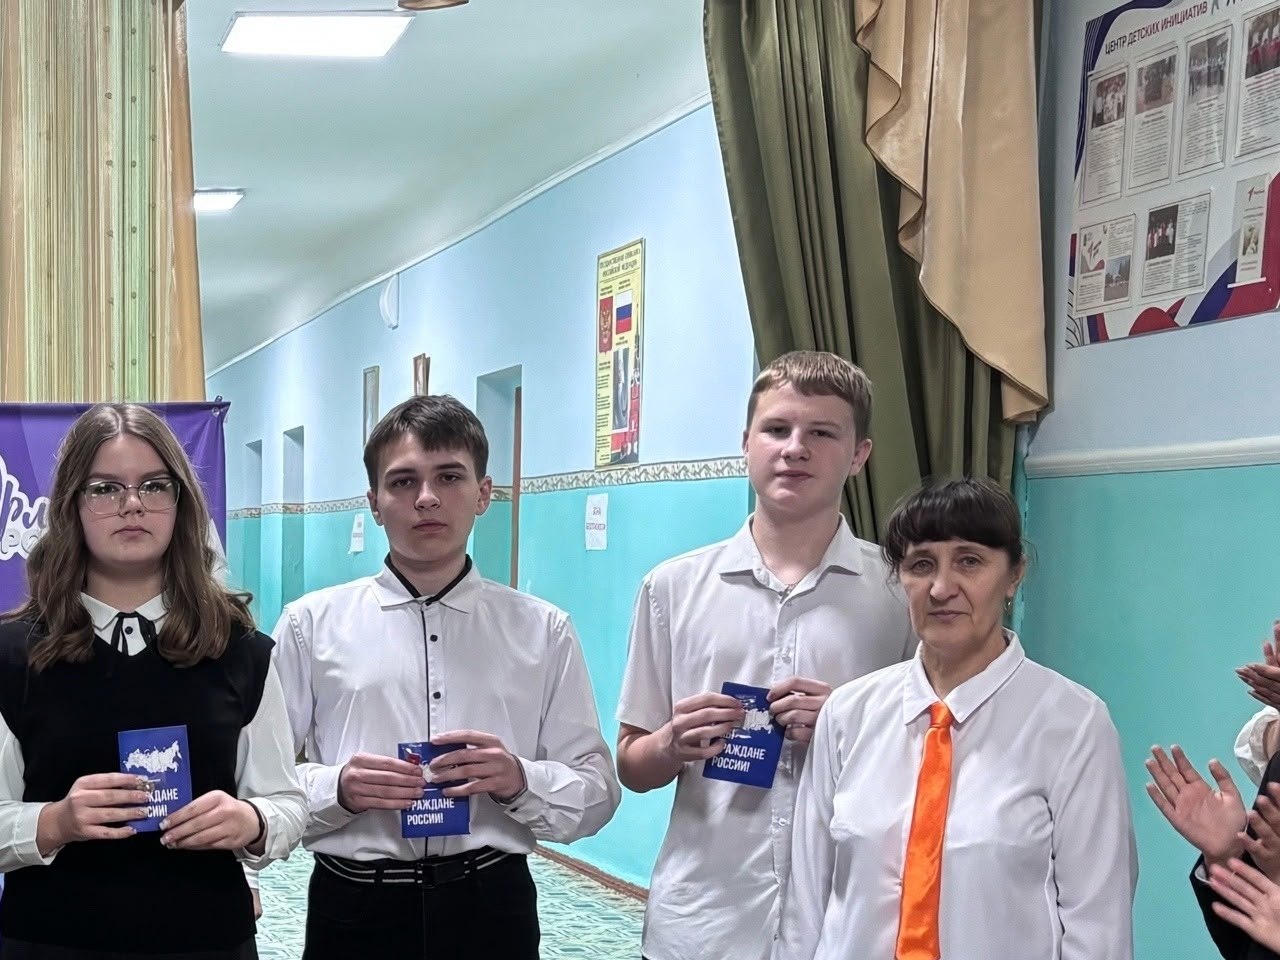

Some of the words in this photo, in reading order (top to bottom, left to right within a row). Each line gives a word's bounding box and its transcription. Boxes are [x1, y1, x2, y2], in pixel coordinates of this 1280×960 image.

[1105, 35, 1128, 55] ЦЕНТР
[1127, 21, 1160, 46] ДЕТСКИХ
[1161, 1, 1208, 31] ИНИЦИАТИВ
[723, 743, 766, 760] АЖДАНЕ
[711, 755, 751, 772] РОССИИ!
[147, 804, 168, 818] СИИ!
[408, 797, 455, 811] РАЖДАНЕ
[406, 812, 444, 826] РОССИИ!
